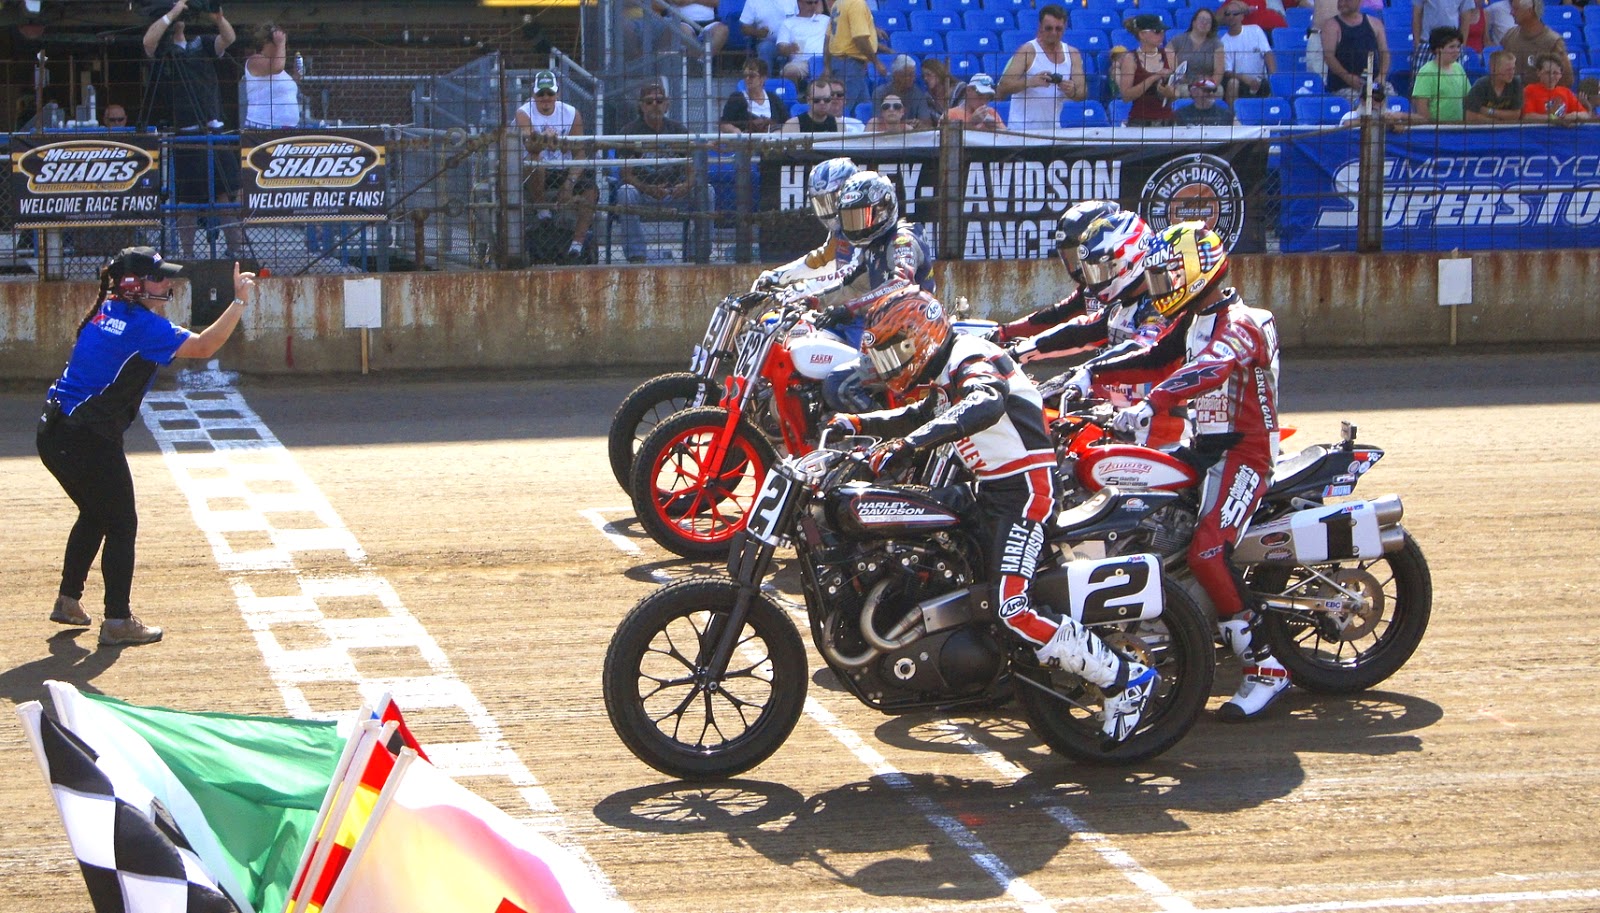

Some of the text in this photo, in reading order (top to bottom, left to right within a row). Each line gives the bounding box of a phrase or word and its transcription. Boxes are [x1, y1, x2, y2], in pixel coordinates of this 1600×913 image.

[43, 147, 128, 162] Memphis
[271, 143, 355, 157] Memphis
[35, 161, 138, 183] SHADES
[263, 157, 366, 178] SHADES
[1399, 155, 1600, 179] MOTORCYC
[963, 160, 1121, 213] AVIDSON
[1316, 158, 1600, 228] SUPERSTO
[20, 195, 158, 214] WELCOME RACE FANS!
[249, 190, 385, 209] WELCOME RACE FANS!
[106, 317, 127, 332] PRO
[1254, 366, 1274, 430] GENE & GAIL
[956, 436, 986, 470] RLEY
[857, 501, 910, 509] HARLEY-
[1000, 520, 1030, 572] HARLEY-
[1020, 522, 1045, 579] DAVIDSON
[1080, 561, 1150, 626] 2
